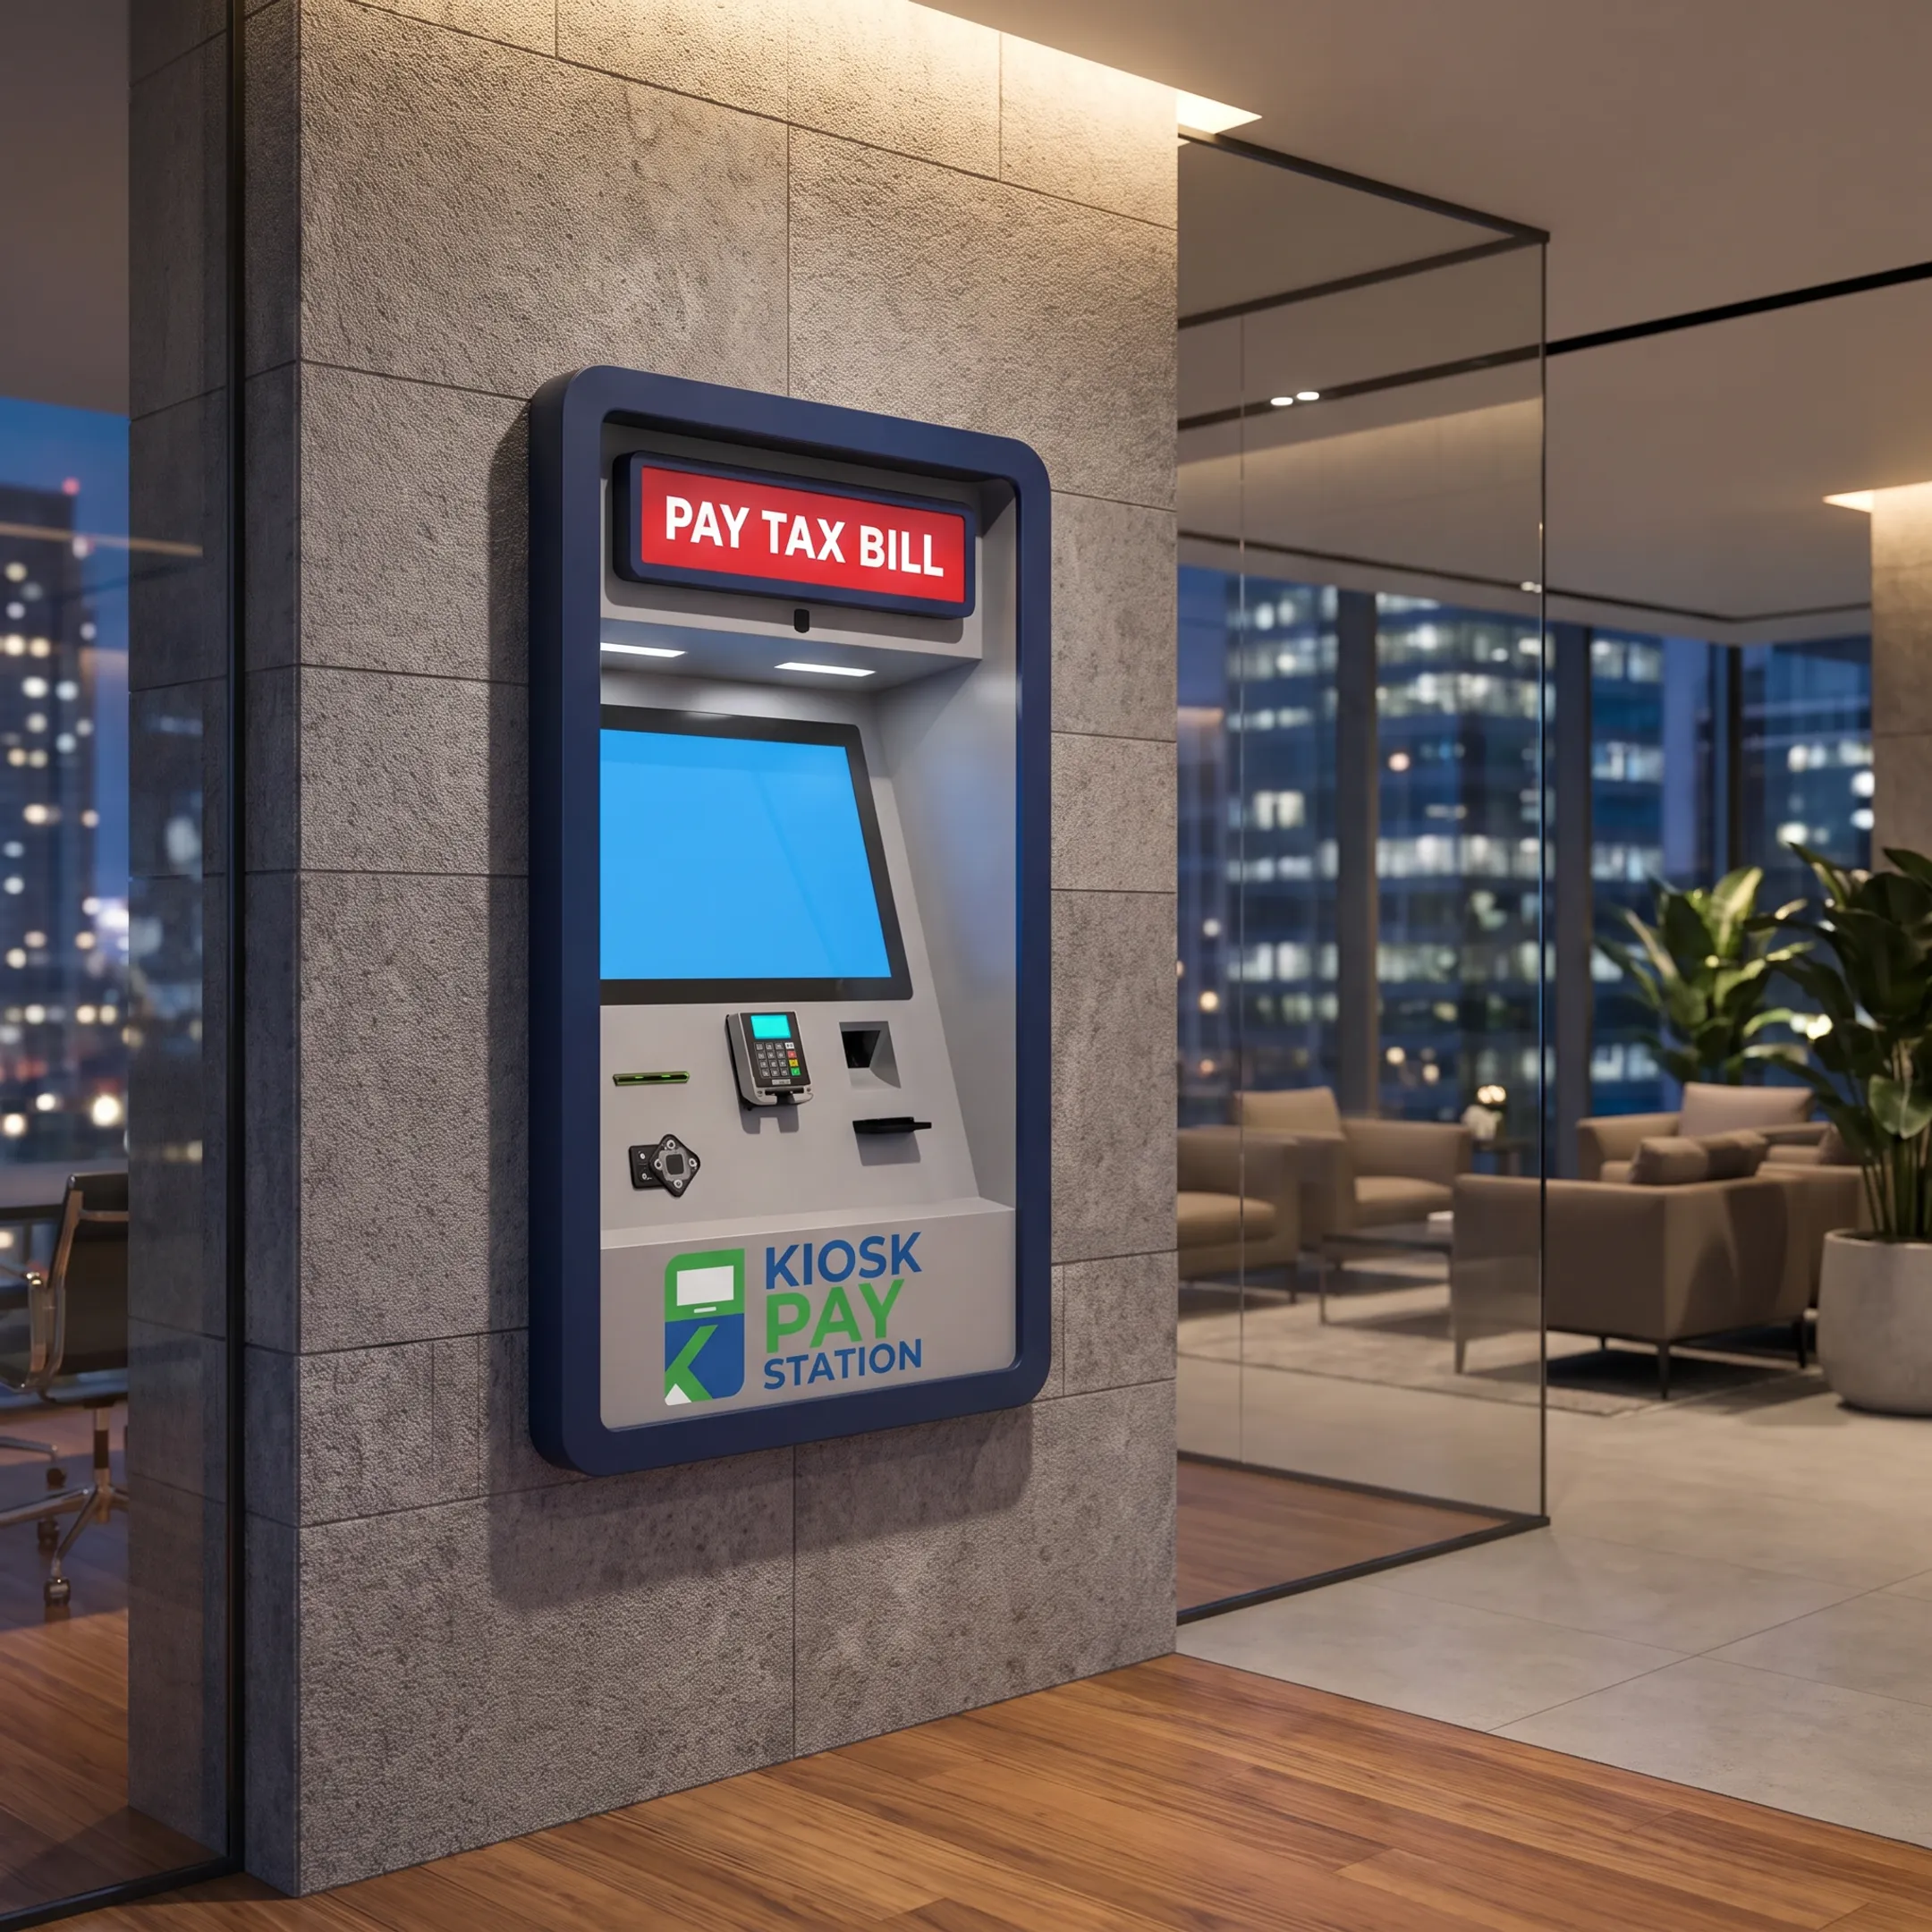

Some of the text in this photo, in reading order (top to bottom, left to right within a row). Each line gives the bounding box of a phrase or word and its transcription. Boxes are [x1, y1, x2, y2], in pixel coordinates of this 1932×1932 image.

[665, 495, 944, 578] PAY TAX BILL
[766, 1232, 922, 1290] KIOSK
[766, 1279, 905, 1354] PAY
[764, 1339, 922, 1390] STATION
